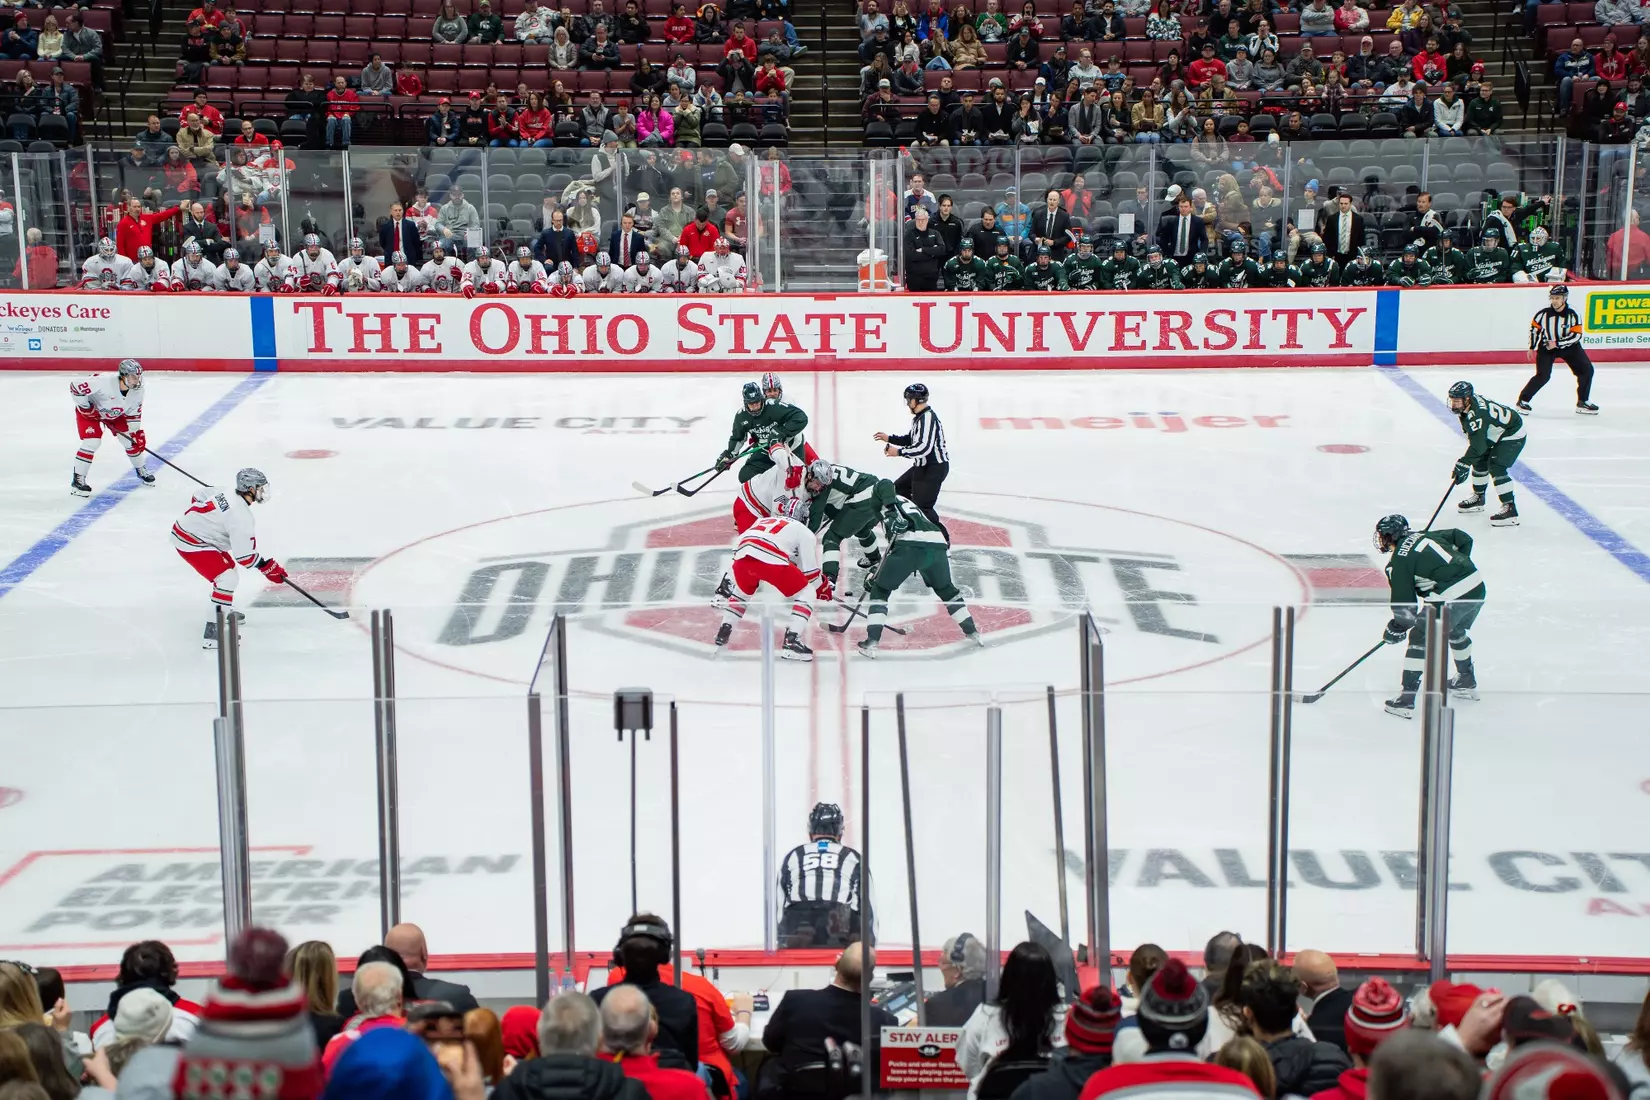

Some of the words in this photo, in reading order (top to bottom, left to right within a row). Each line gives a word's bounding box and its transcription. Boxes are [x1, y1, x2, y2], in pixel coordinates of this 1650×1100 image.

[66, 303, 111, 319] Care
[293, 301, 443, 354] THE
[468, 301, 650, 355] OHIO
[676, 301, 888, 355] STATE
[911, 300, 1369, 354] UNIVERSITY
[1583, 335, 1603, 343] Real
[1605, 335, 1634, 343] Estate
[331, 416, 542, 430] VALUE
[553, 416, 707, 429] CITY
[979, 411, 1293, 434] meijer
[1469, 417, 1483, 432] 27
[749, 517, 790, 535] 21
[1414, 537, 1454, 564] 7
[802, 852, 840, 871] 58
[889, 1032, 922, 1043] STAY
[925, 1033, 958, 1043] ALER
[886, 1075, 903, 1083] Keep
